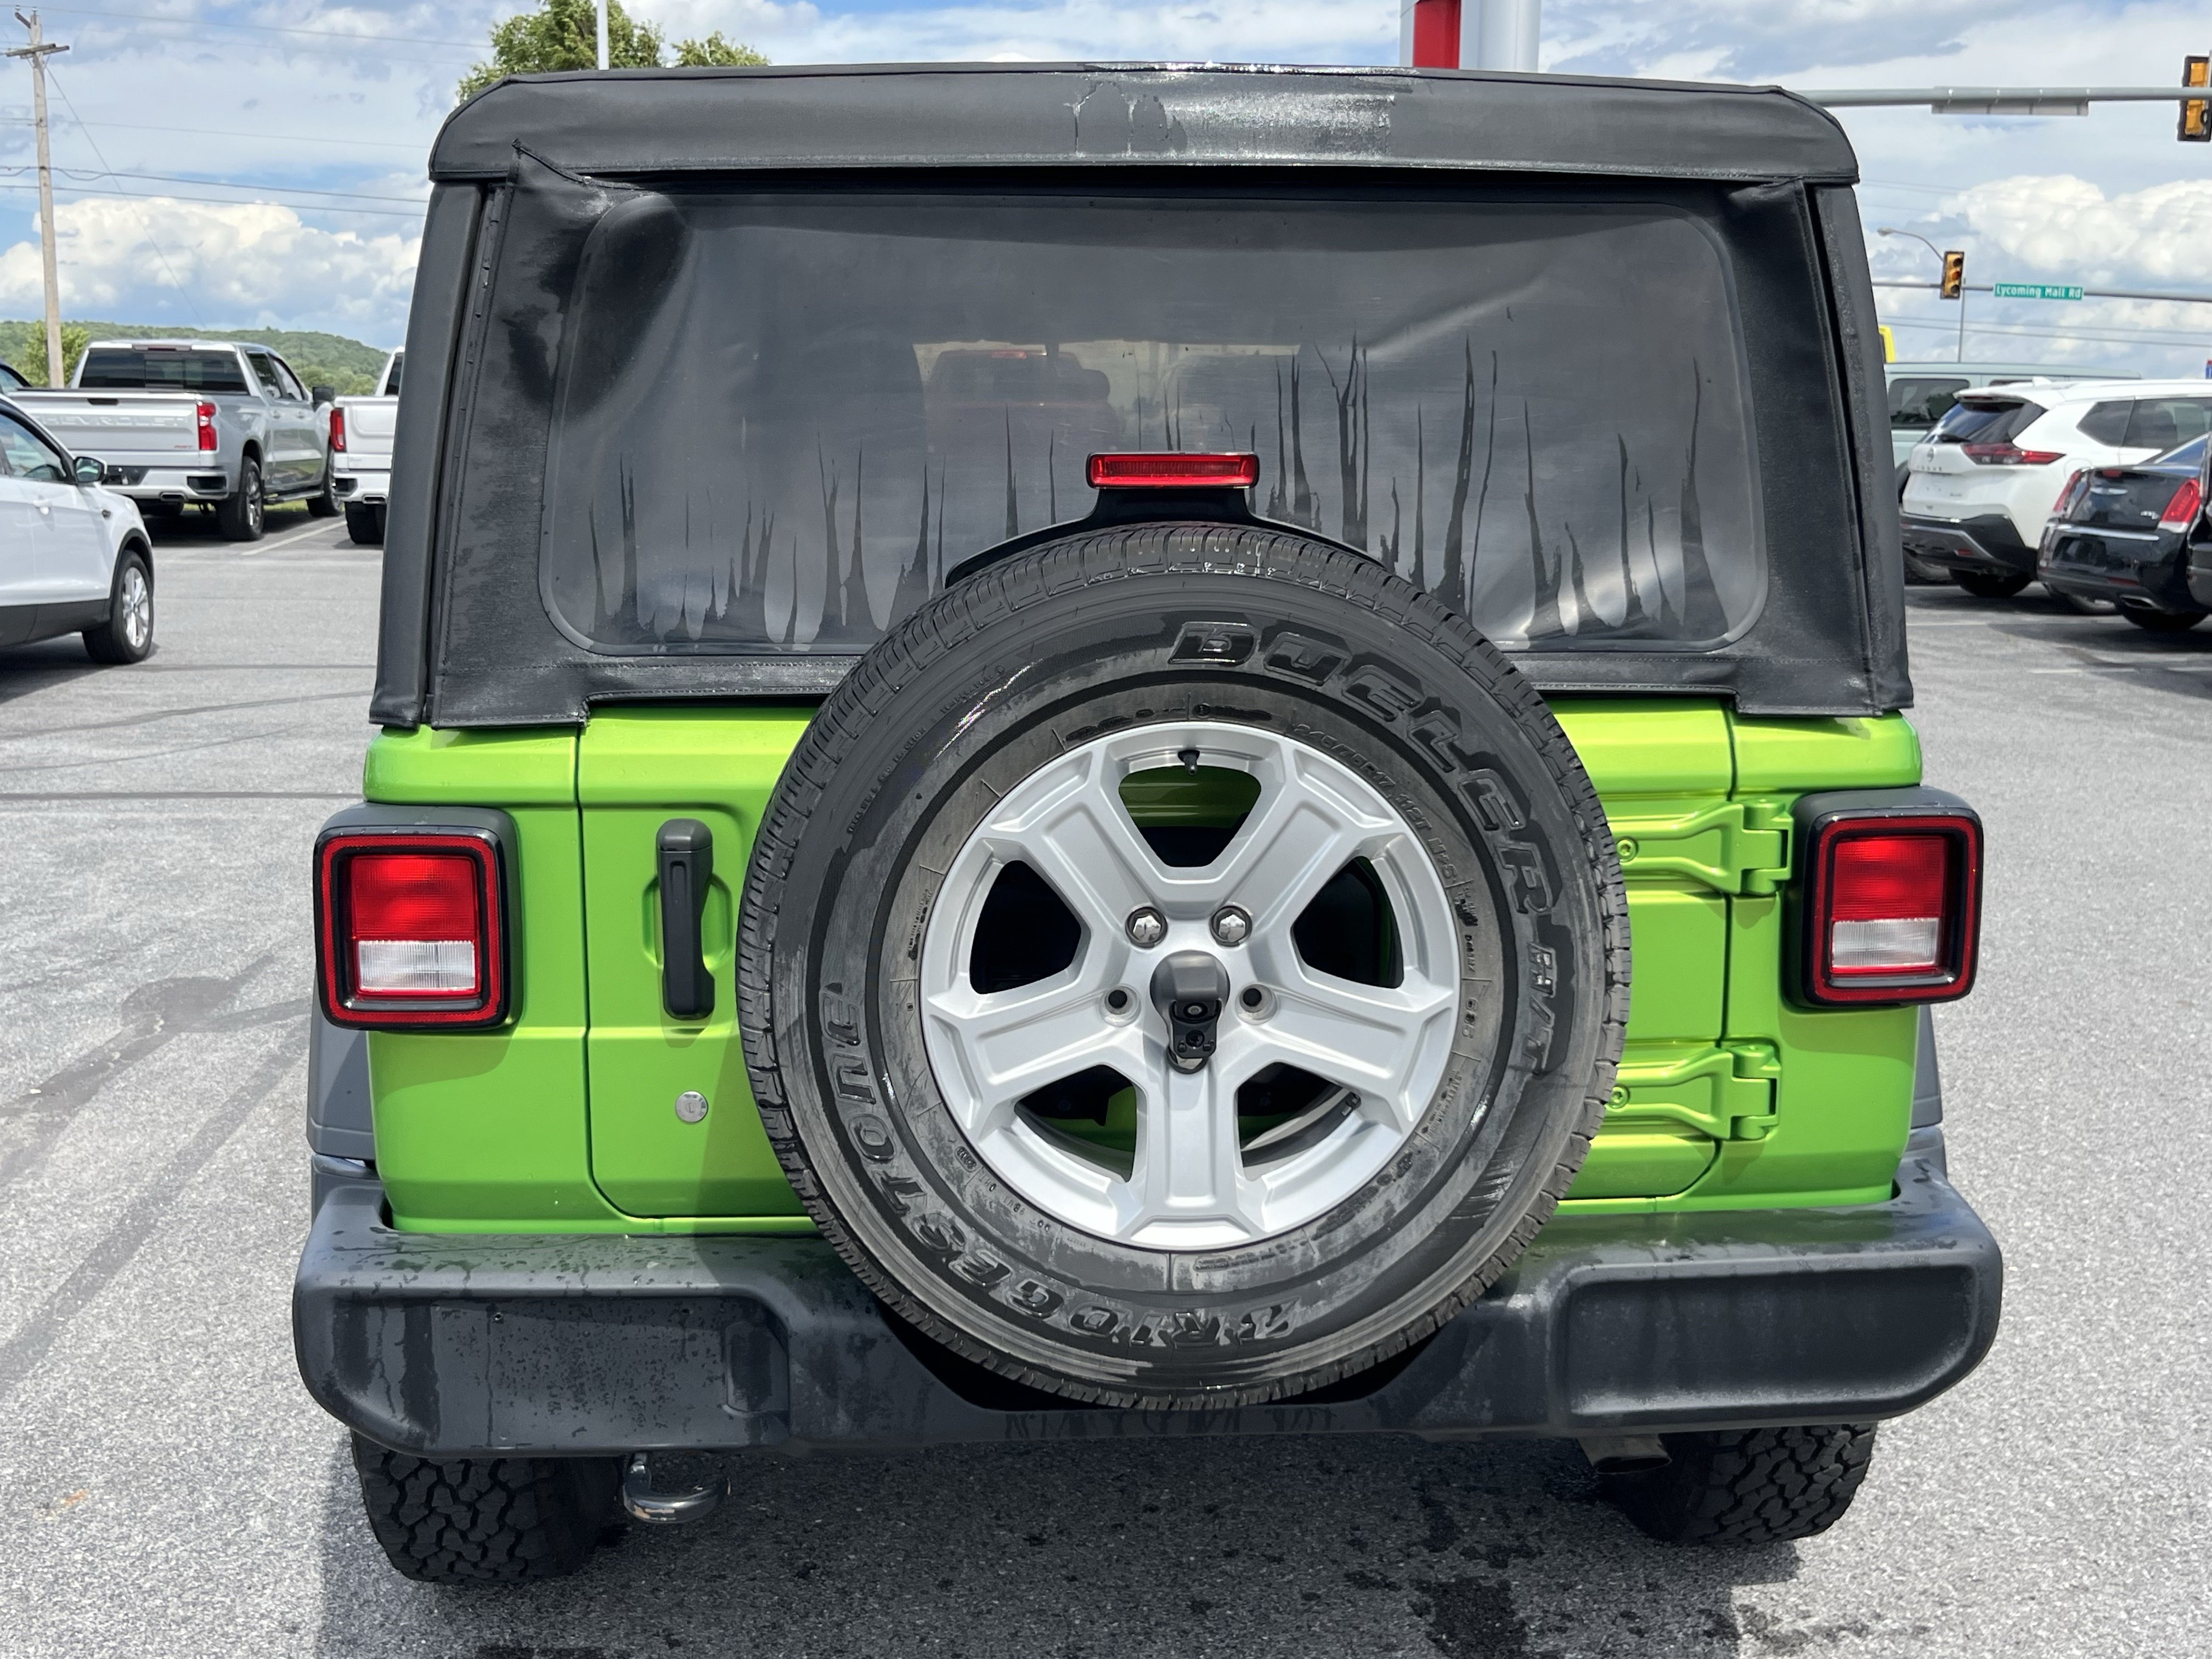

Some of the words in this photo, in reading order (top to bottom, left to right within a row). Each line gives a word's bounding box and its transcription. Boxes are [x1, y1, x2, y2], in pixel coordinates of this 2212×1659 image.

[1996, 284, 2041, 299] Lycoming
[2045, 287, 2066, 298] Mall
[2068, 287, 2081, 299] Rd
[1167, 619, 1548, 915] DUELER
[1522, 940, 1557, 1074] H/T
[1293, 723, 1396, 789] 245/75R17
[1395, 793, 1432, 831] 112T
[1427, 837, 1458, 881] M+S
[820, 989, 1305, 1348] BRIDGESTONE
